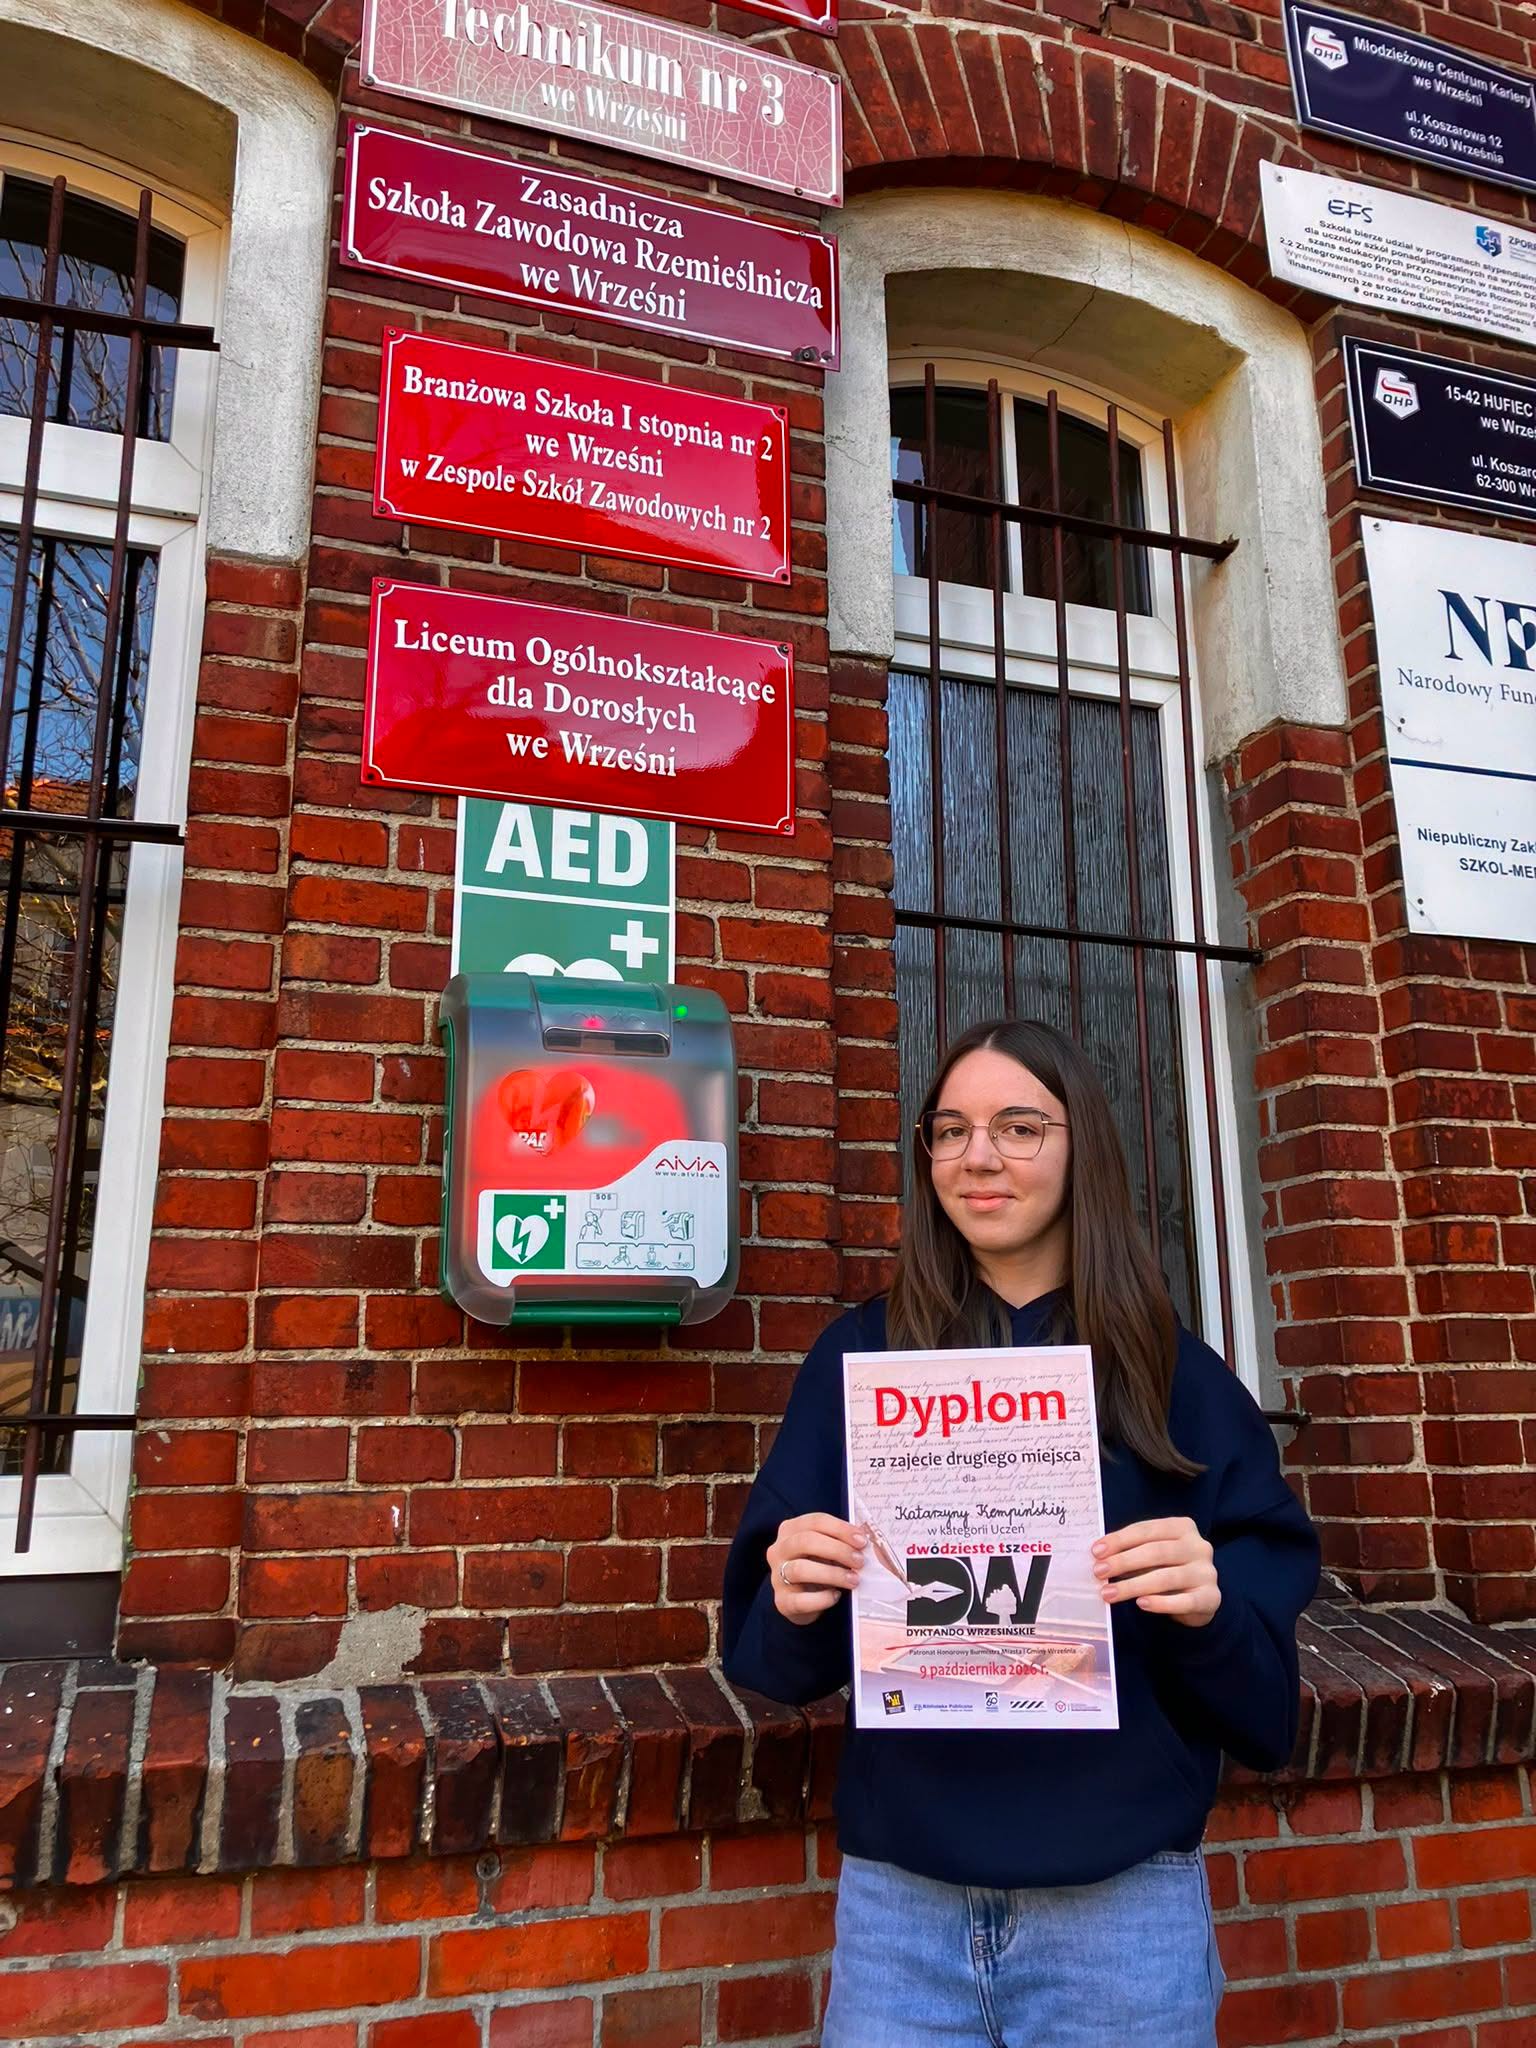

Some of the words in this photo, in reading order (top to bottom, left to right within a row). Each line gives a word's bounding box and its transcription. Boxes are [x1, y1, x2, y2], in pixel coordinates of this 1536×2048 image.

[442, 0, 684, 99] Technikum
[701, 68, 748, 115] nr
[761, 73, 785, 127] 3
[1353, 36, 1435, 73] Młodzieżowe
[1437, 62, 1488, 92] Centrum
[1490, 80, 1531, 108] Kariery
[1413, 74, 1432, 90] we
[1435, 78, 1483, 107] Wrześni
[540, 81, 575, 113] we
[585, 88, 687, 142] Wrześni
[1405, 110, 1420, 124] ul.
[1423, 116, 1487, 143] Koszarowa
[1488, 134, 1503, 149] 12
[1409, 127, 1448, 148] 62-300
[1452, 139, 1504, 165] Września
[520, 175, 684, 239] Zasadnicza
[1327, 199, 1374, 224] EFS
[368, 177, 467, 229] Szkoła
[474, 200, 628, 266] Zawodowa
[634, 238, 824, 310] Rzemieślnicza
[1304, 226, 1320, 236] dla
[1354, 229, 1383, 242] bierze
[1426, 248, 1481, 268] programach
[1280, 236, 1294, 247] 2.2
[1295, 242, 1373, 268] Zintegrowanego
[1375, 262, 1421, 281] Programu
[1424, 275, 1487, 298] Operacyjnego
[1308, 237, 1336, 250] szans
[1338, 245, 1404, 268] edukacyjnych
[1406, 263, 1477, 286] przyznawanych
[1488, 284, 1522, 296] ramach
[520, 262, 561, 295] we
[570, 264, 687, 321] Wrześni
[1362, 289, 1384, 300] oraz
[1419, 292, 1485, 314] Europejskiego
[403, 364, 527, 412] Branżowa
[534, 387, 615, 428] Szkoła
[621, 403, 631, 429] I
[638, 413, 724, 456] stopnia
[730, 433, 756, 457] nr
[760, 435, 774, 462] 2
[1445, 384, 1481, 406] 15-42
[1483, 392, 1533, 418] HUFIEC
[1480, 415, 1500, 430] we
[525, 430, 560, 458] we
[567, 432, 664, 477] Wrześni
[1472, 454, 1487, 469] ul.
[400, 457, 420, 478] w
[425, 454, 517, 496] Zespole
[522, 469, 584, 504] Szkół
[589, 482, 727, 533] Zawodowych
[732, 513, 756, 536] nr
[759, 514, 771, 541] 2
[1476, 473, 1516, 494] 62-300
[394, 618, 515, 662] Liceum
[525, 636, 776, 705] Ogólnokształcące
[486, 676, 534, 711] dla
[544, 681, 697, 734] Dorosłych
[1397, 666, 1492, 703] Narodowy
[1500, 683, 1536, 705] Fun
[506, 731, 549, 759] we
[560, 731, 677, 777] Wrześni
[484, 803, 649, 887] AED
[1417, 827, 1507, 853] Niepubliczny
[875, 1380, 1067, 1438] Dyplom
[869, 1456, 886, 1468] za
[946, 1450, 1018, 1470] drugiego
[1021, 1448, 1081, 1467] miejsca
[962, 1474, 977, 1484] dla
[895, 1504, 970, 1529] Katarzyny
[976, 1499, 1067, 1526] Kempińskiej
[927, 1528, 938, 1536] w
[940, 1524, 989, 1538] kategorii
[991, 1523, 1026, 1535] Uczeń
[906, 1542, 995, 1556] dwódzieste
[1000, 1540, 1053, 1553] tszecie
[906, 1555, 1052, 1626] DW
[906, 1628, 965, 1637] DYKTANDO
[937, 1649, 969, 1657] Honorowy
[1002, 1647, 1022, 1655] Miasta
[920, 1665, 927, 1679] 9
[931, 1661, 1007, 1679] października
[1009, 1662, 1037, 1676] 2026
